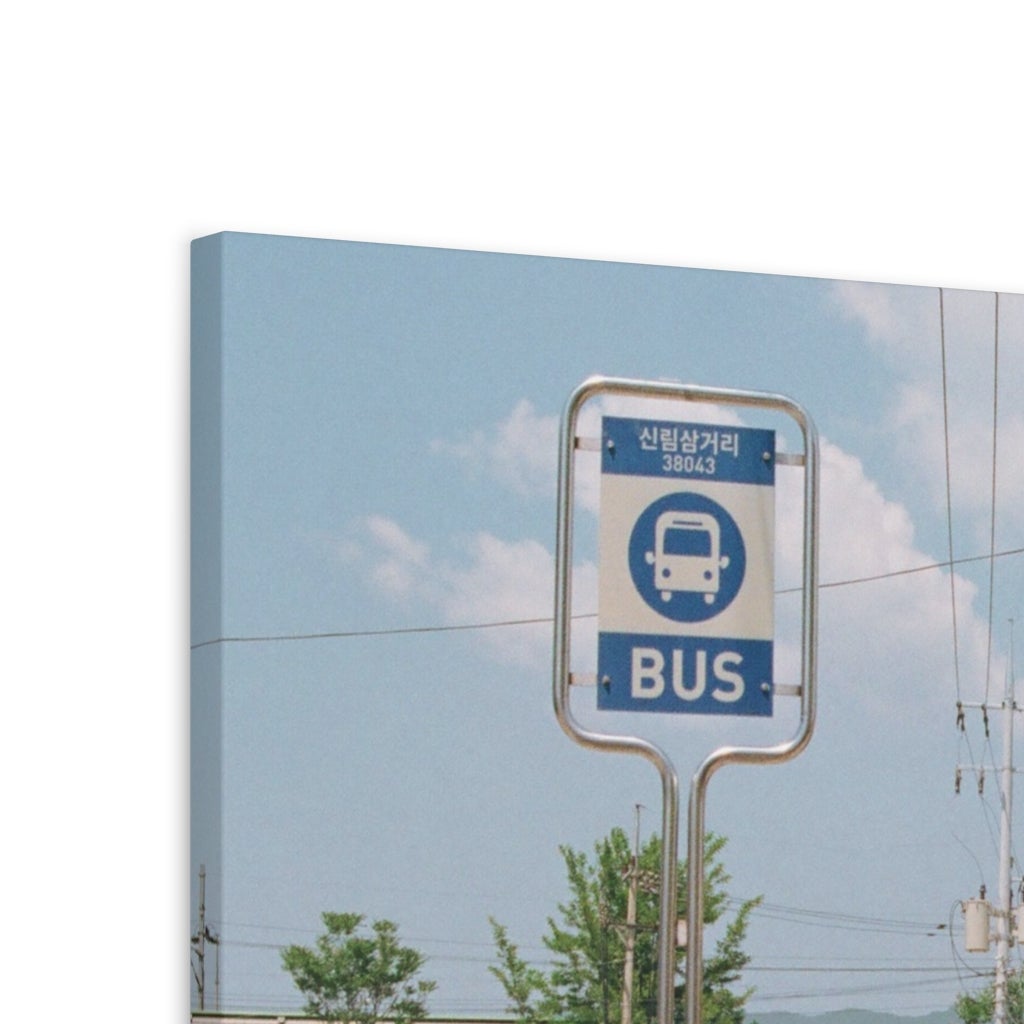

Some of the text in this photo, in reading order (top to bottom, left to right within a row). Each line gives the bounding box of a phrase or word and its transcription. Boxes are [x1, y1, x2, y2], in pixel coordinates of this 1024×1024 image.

[638, 428, 740, 457] 신림삼거리
[662, 454, 716, 474] 38043
[630, 647, 746, 703] BUS
